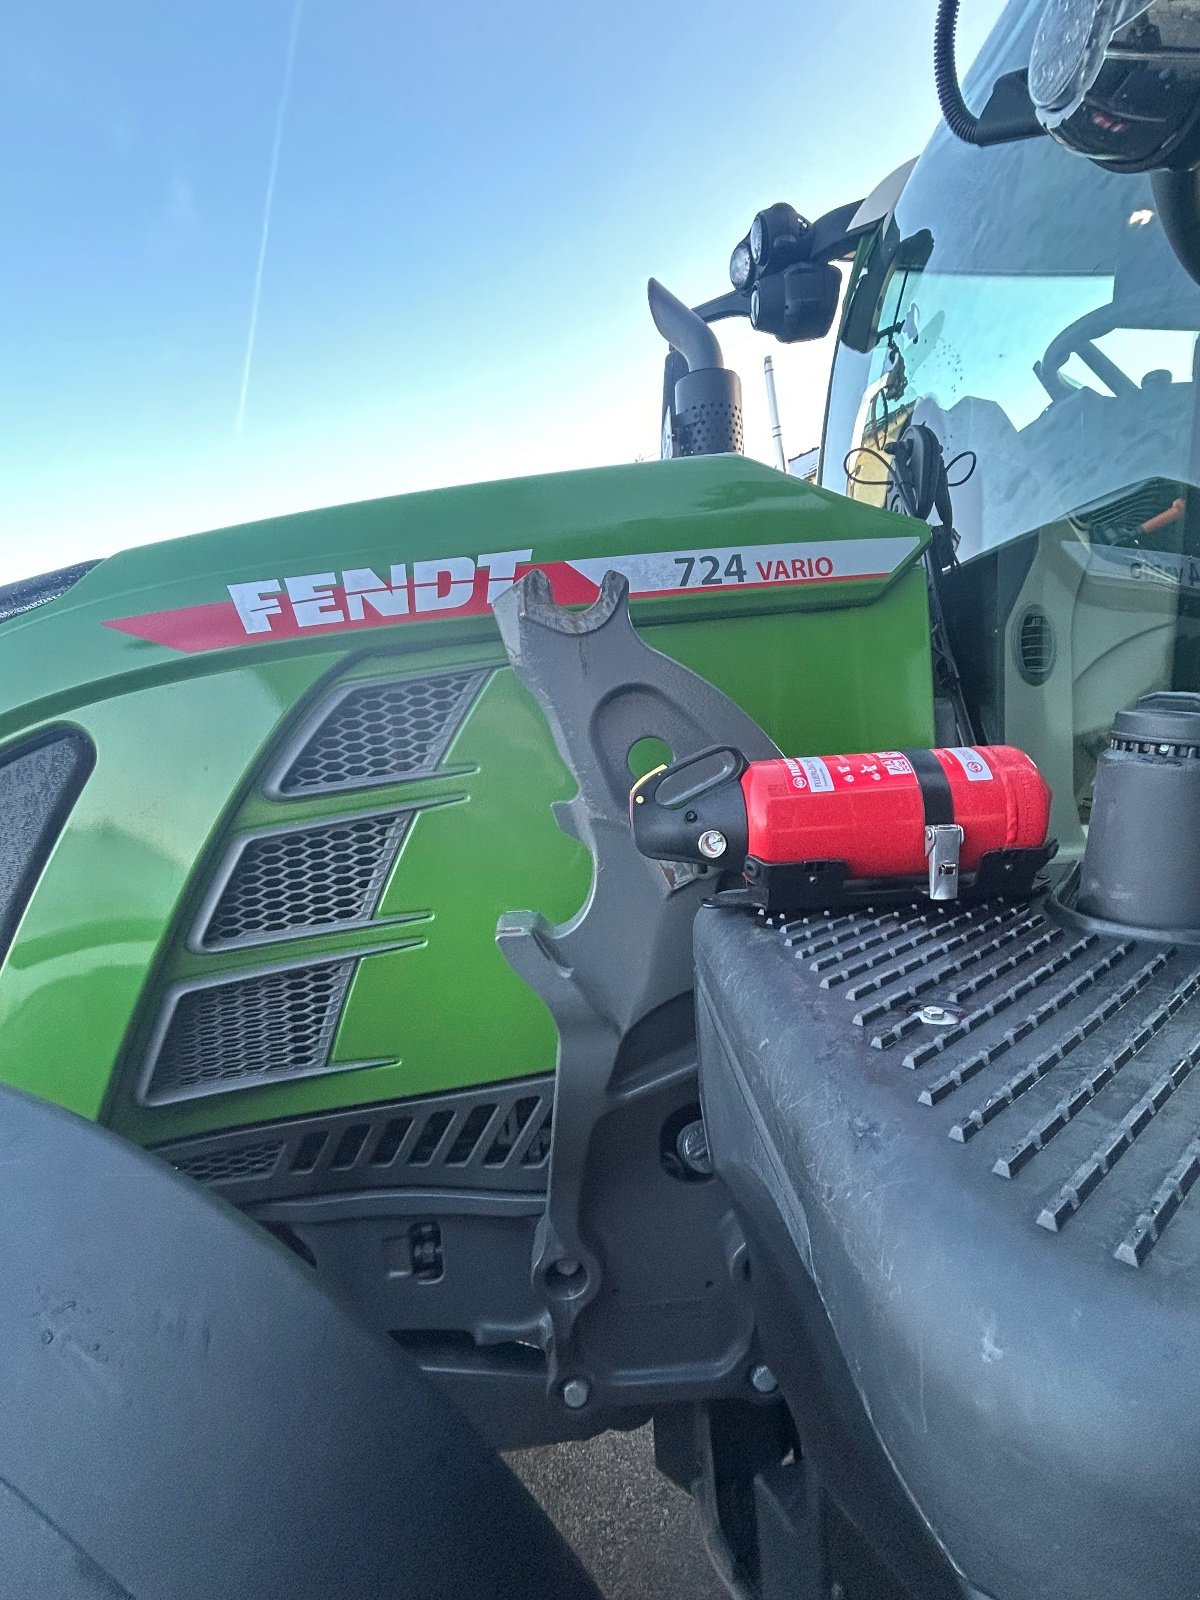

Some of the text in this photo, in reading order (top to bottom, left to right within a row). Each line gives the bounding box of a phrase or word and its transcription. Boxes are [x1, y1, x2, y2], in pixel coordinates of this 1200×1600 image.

[226, 548, 533, 634] FENDT
[674, 553, 834, 586] 724 VARIO
